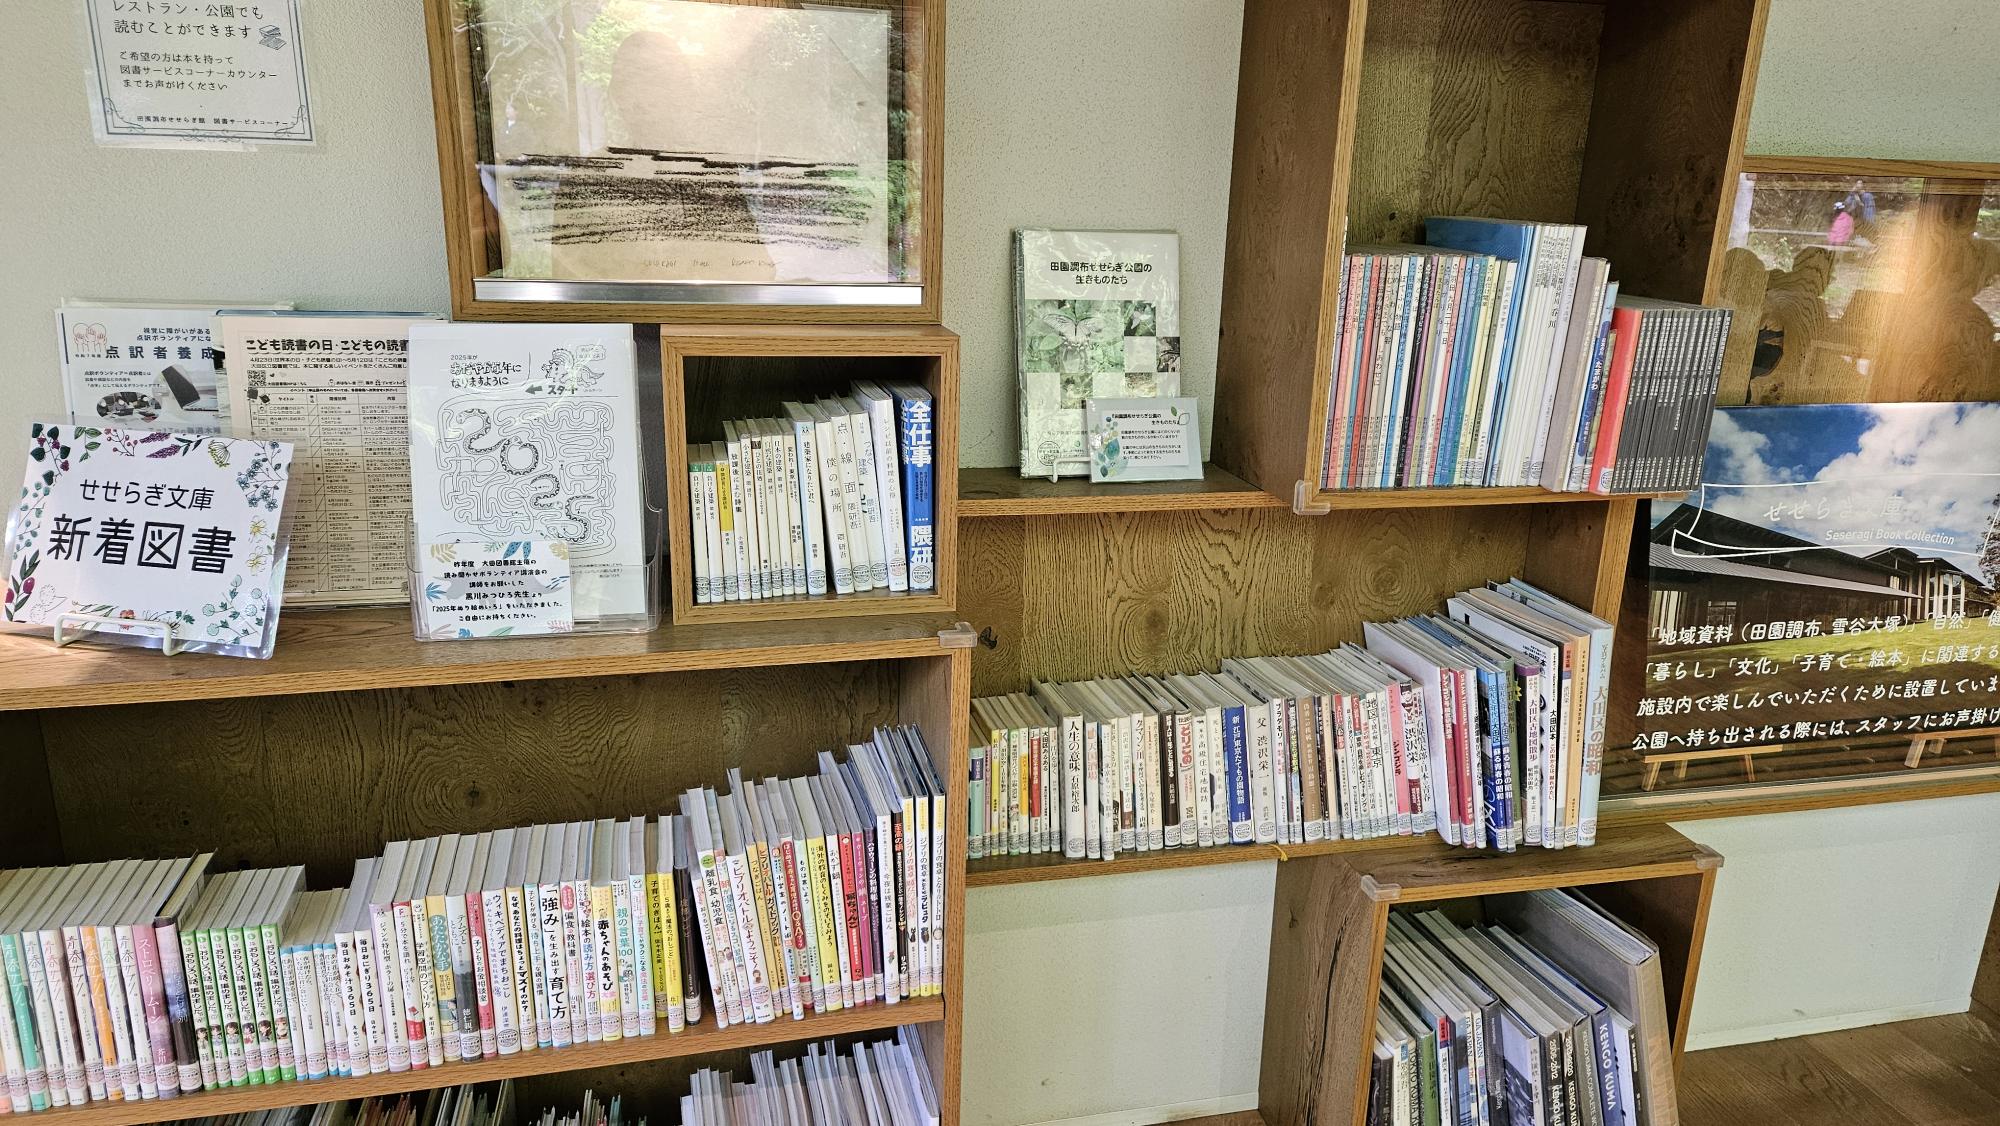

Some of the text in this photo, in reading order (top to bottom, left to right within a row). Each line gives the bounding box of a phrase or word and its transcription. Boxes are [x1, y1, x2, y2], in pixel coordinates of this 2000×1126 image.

[113, 0, 265, 20] レストラン・公園でも
[114, 19, 252, 38] 読むことができます
[119, 51, 234, 65] ご希望の方は本を持って
[119, 65, 277, 79] 図書サービスコーナーカウンター
[122, 79, 228, 90] までお声がけください
[1050, 261, 1153, 274] 田園調布せせらぎ公園の
[1075, 274, 1129, 286] 生きものたち
[908, 402, 932, 468] 全仕事
[80, 477, 215, 512] せせらぎ文庫
[47, 513, 236, 575] 新着図書
[1825, 529, 1955, 545] Seseragi Book Collection
[1232, 715, 1240, 725] 新
[1528, 699, 1539, 762] 大田区古地図散歩
[1586, 685, 1608, 777] 大田区の昭和
[1068, 720, 1081, 773] 人生の意味
[1256, 717, 1270, 779] 父 渋沢栄一
[705, 869, 725, 926] 離乳食・幼児食
[799, 859, 809, 905] ものは言いよう
[493, 894, 511, 998] ウィキペディアでまちおこし
[564, 911, 577, 957] 偏食の教科書
[616, 907, 630, 948] 親の言葉
[359, 938, 375, 1013] 毎日おにぎり365日
[542, 889, 567, 1020] 「強み」を生み出す育て方
[597, 919, 614, 991] 赤ちゃんのあそび
[138, 938, 162, 1025] ストロベリームーン
[340, 941, 357, 1016] 毎日おみそ汁365日
[1599, 1023, 1612, 1069] KENGO
[1568, 1080, 1576, 1111] KENGO
